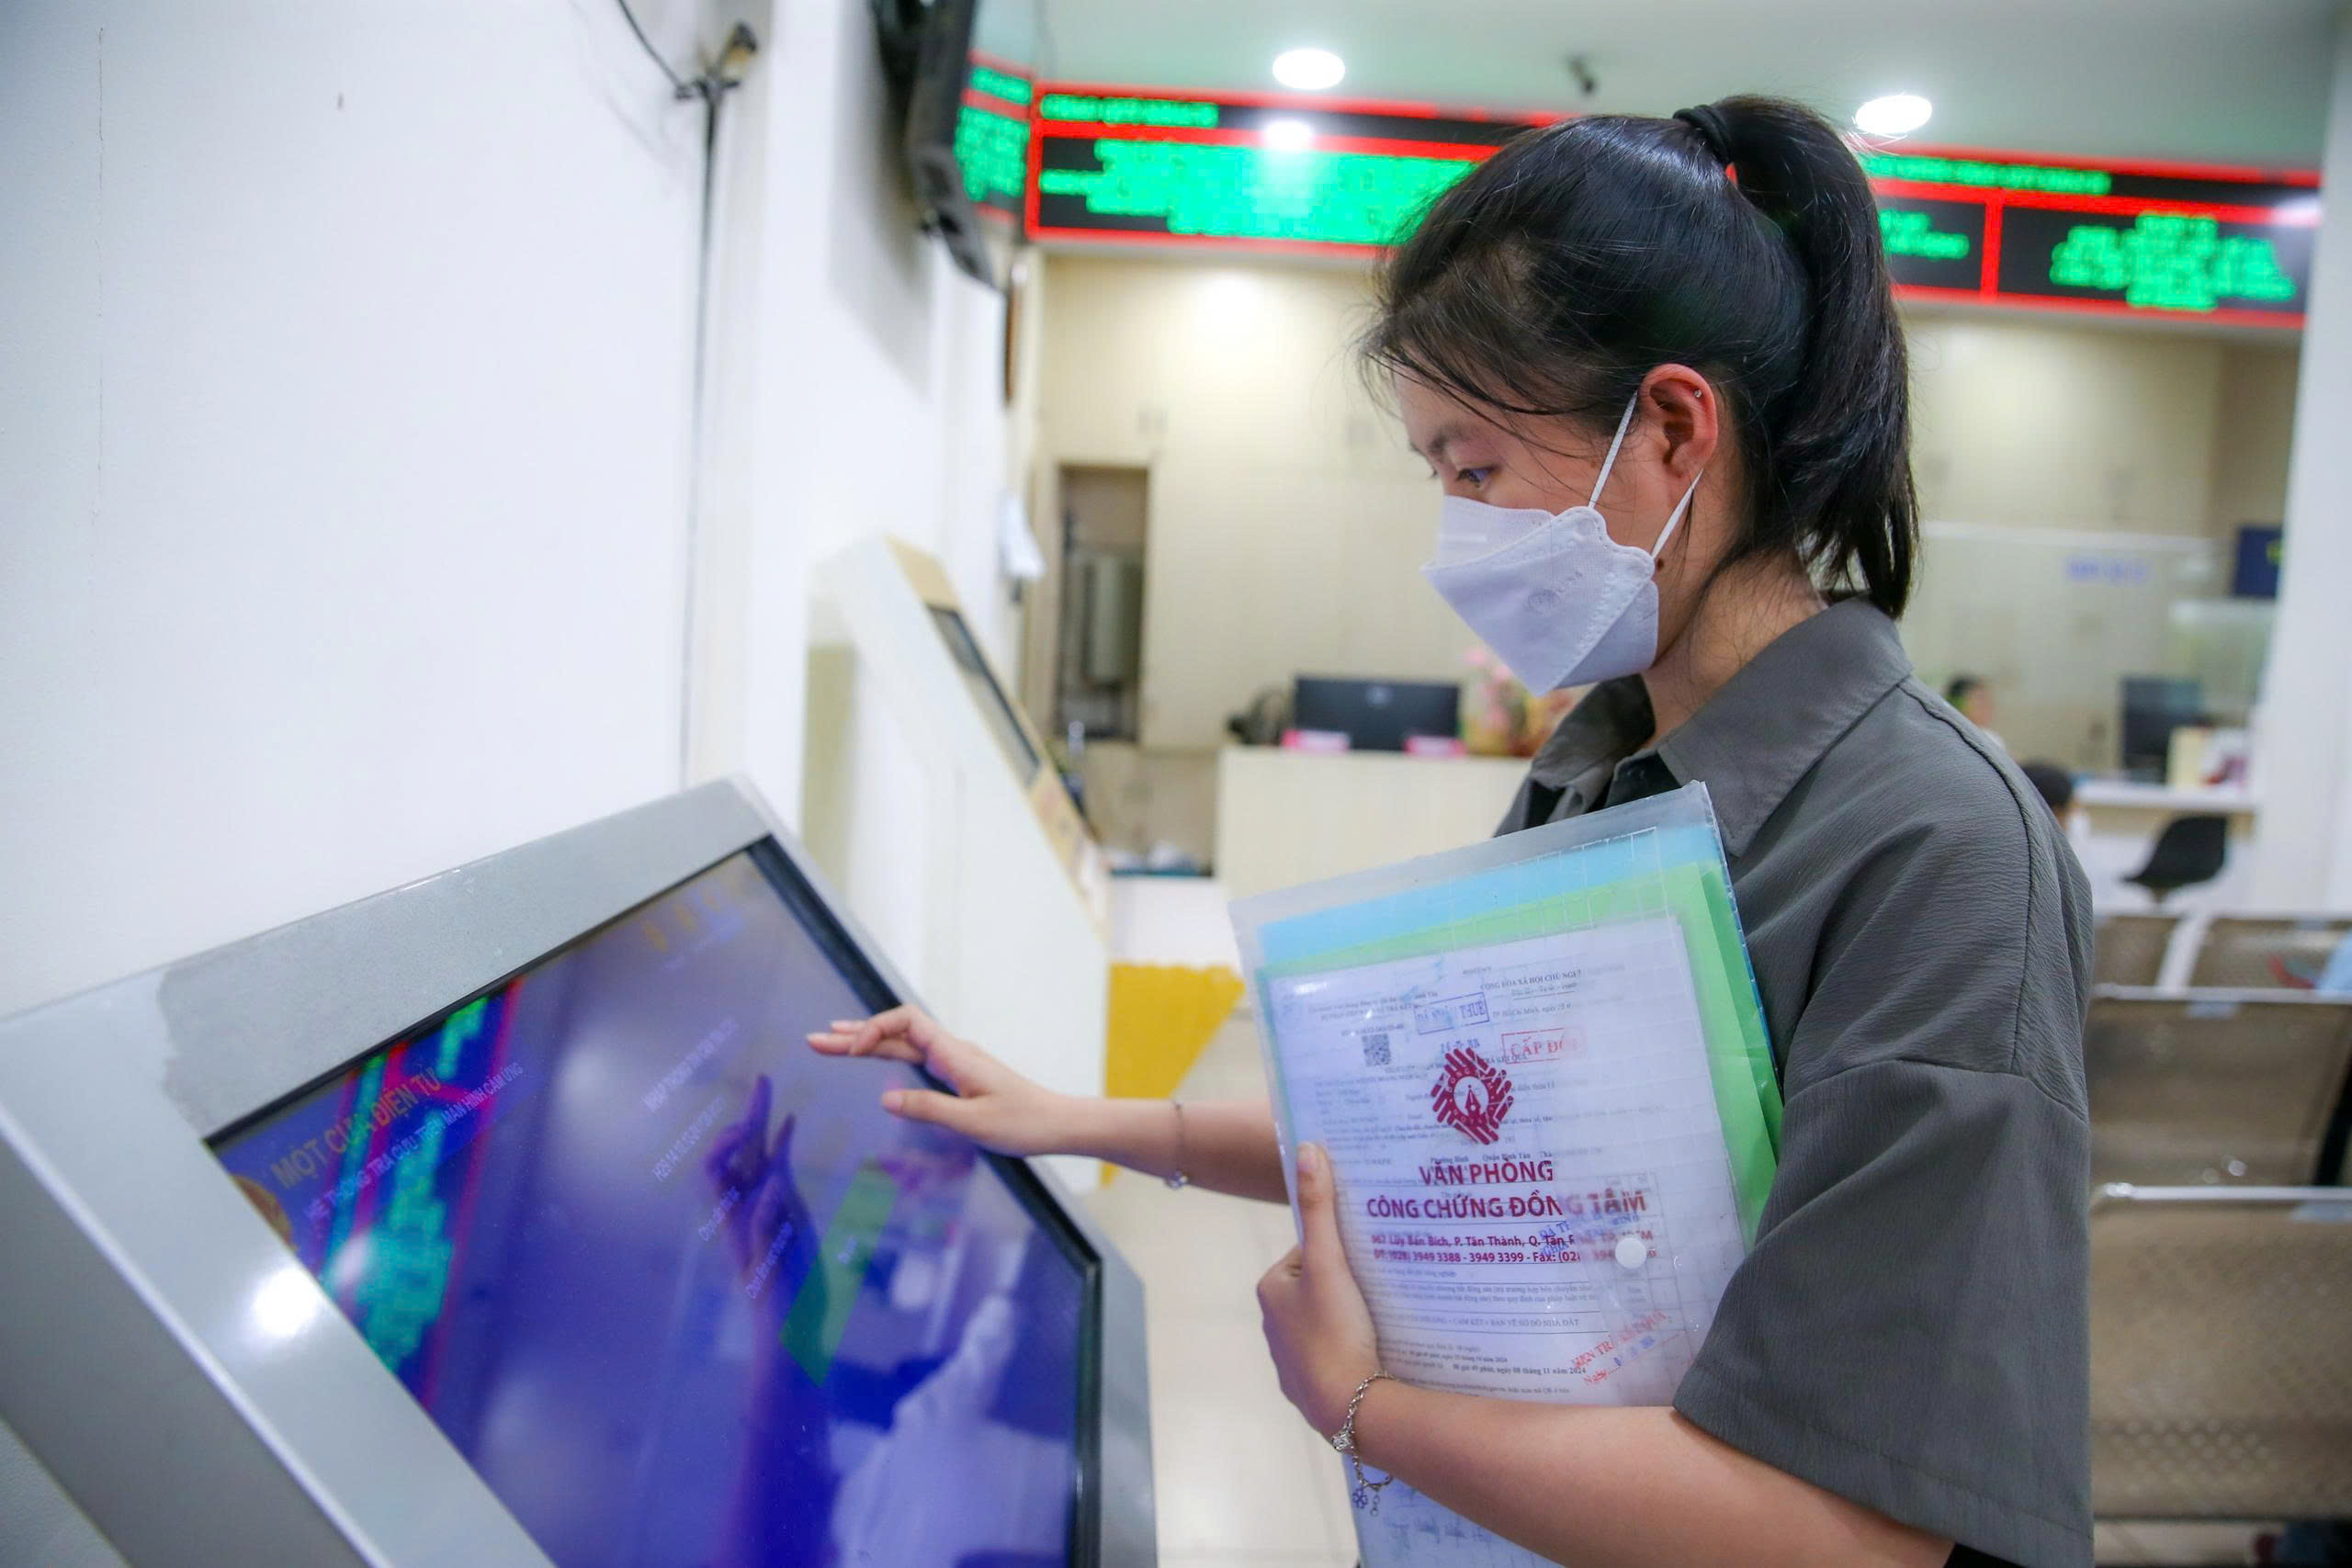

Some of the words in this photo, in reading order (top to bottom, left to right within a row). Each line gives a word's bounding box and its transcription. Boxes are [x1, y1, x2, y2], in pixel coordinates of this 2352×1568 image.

[1419, 1160, 1464, 1186] VĂN
[1469, 1157, 1554, 1184] PHÒNG
[1367, 1195, 1419, 1219] CÔNG
[1423, 1193, 1505, 1219] CHỨNG
[1509, 1189, 1583, 1218] ĐỒNG
[1454, 1236, 1464, 1247] P.
[1466, 1235, 1485, 1247] Tân
[1486, 1235, 1525, 1248] Thành,
[1528, 1235, 1541, 1247] Q.
[1544, 1235, 1565, 1246] Tân
[1437, 1252, 1461, 1262] 3388
[1470, 1252, 1496, 1262] 3949
[1498, 1252, 1523, 1262] 3399
[1532, 1252, 1556, 1262] Fax:
